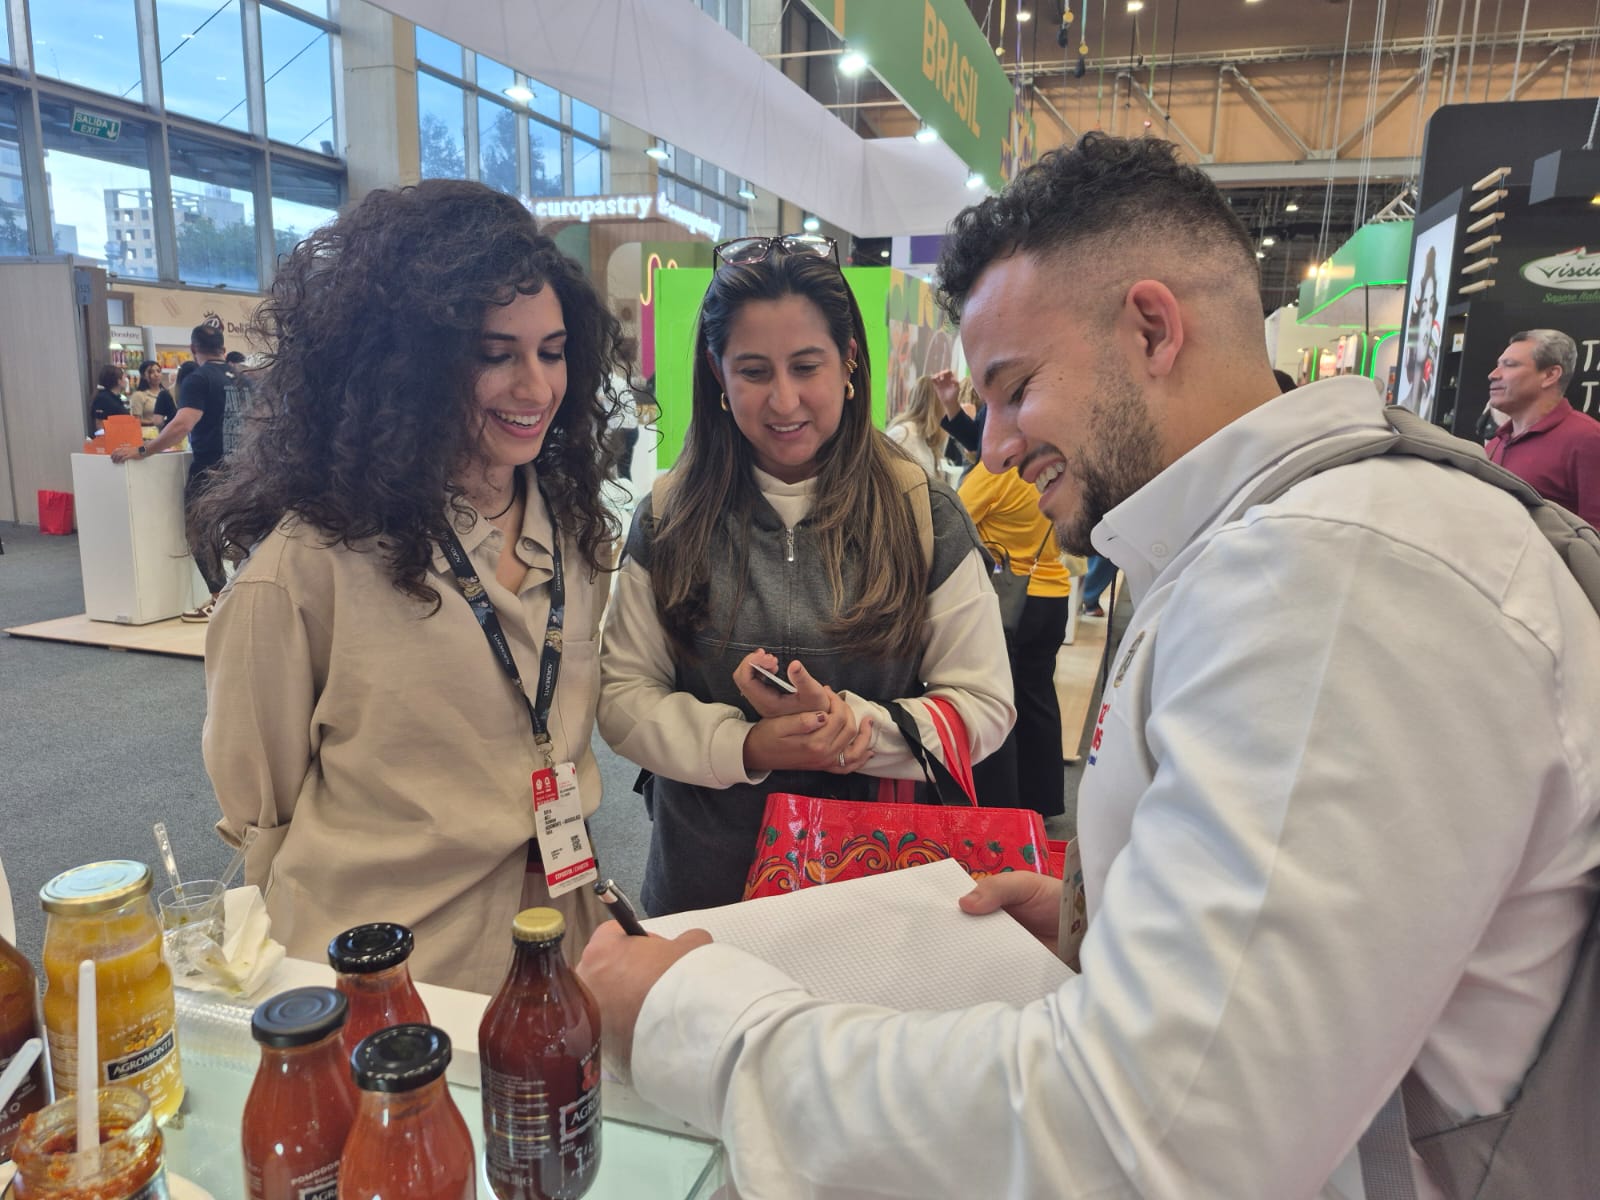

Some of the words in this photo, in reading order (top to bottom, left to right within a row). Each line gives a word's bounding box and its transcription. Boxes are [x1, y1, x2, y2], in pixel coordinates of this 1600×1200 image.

[922, 0, 981, 139] BRASIL
[76, 113, 108, 129] SALIDA
[80, 123, 101, 135] EXIT
[535, 195, 653, 223] europastry
[290, 1160, 340, 1186] POMODOR
